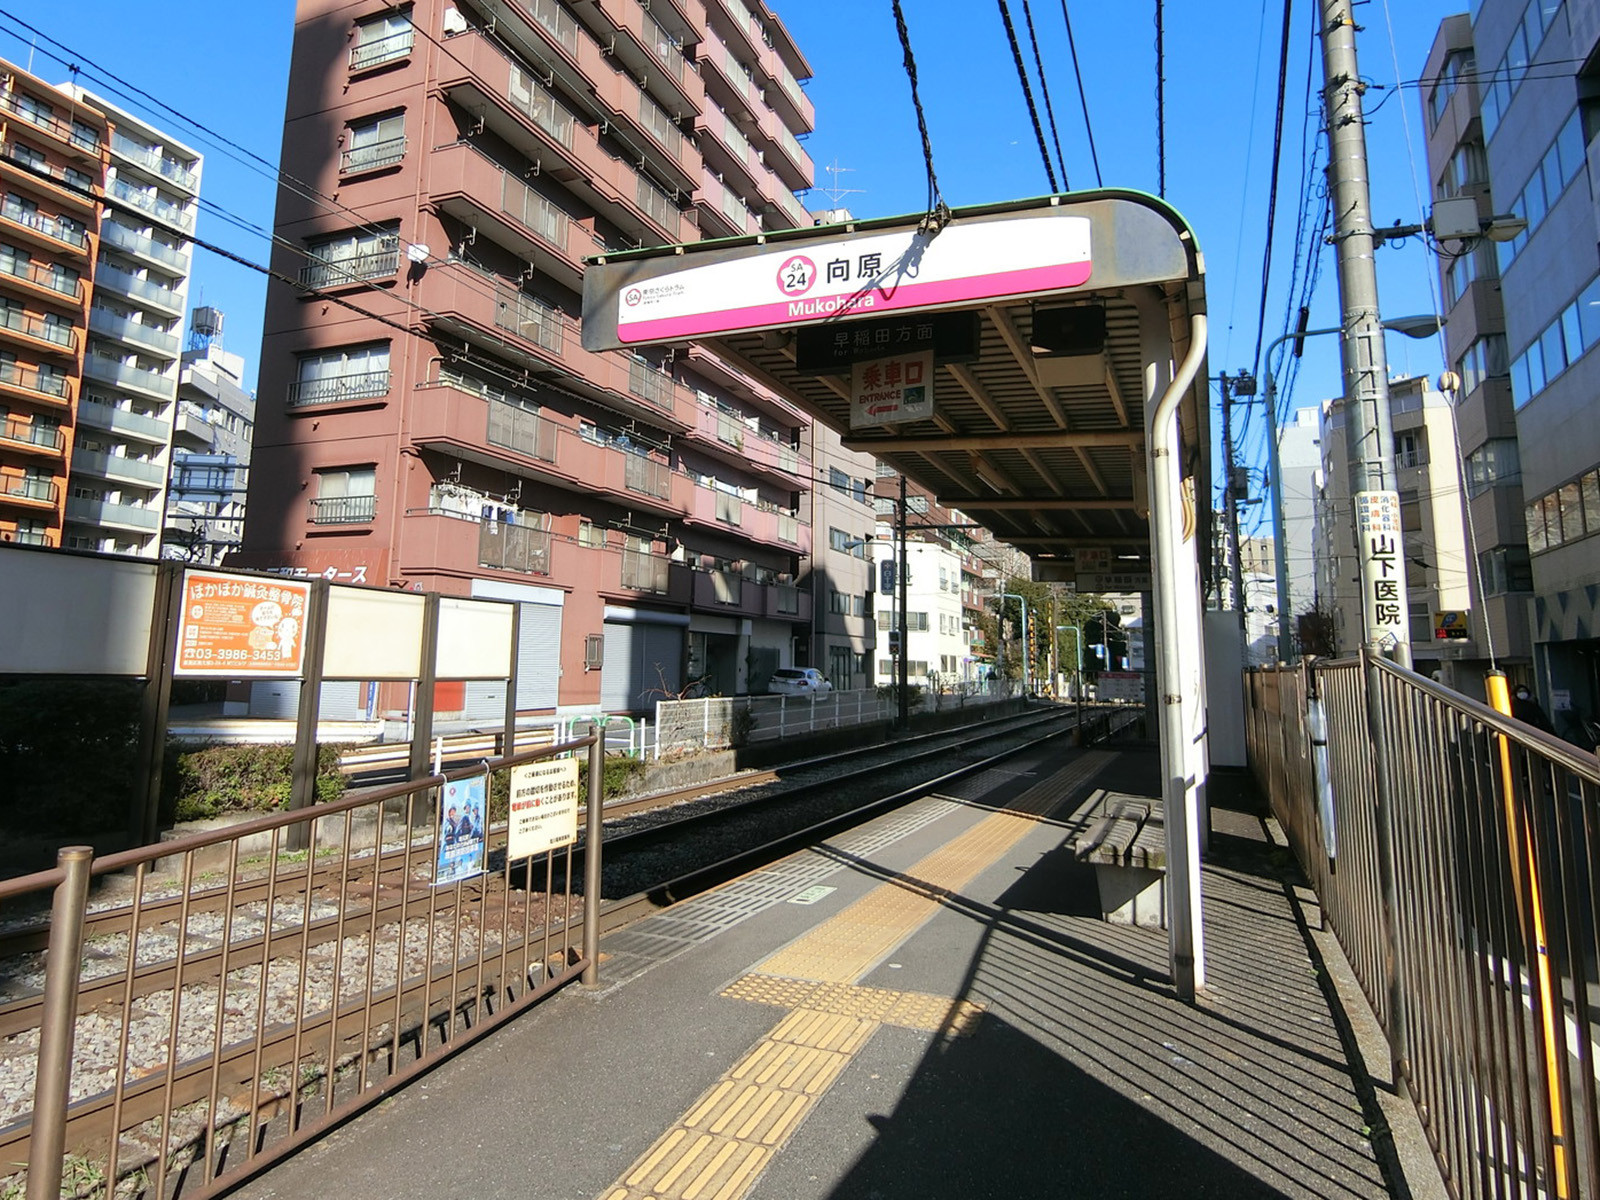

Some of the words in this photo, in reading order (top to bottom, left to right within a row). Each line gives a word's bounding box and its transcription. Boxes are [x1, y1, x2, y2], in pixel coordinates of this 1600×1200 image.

[790, 263, 804, 272] SA
[826, 252, 883, 284] 向原
[786, 272, 807, 288] 24
[628, 293, 639, 302] SA
[788, 295, 875, 317] Mukohara
[833, 323, 934, 348] 早稲田方面
[833, 348, 849, 357] for
[862, 360, 924, 392] 乗車口
[858, 389, 902, 405] ENTRANCE
[1370, 495, 1382, 532] 皮膚科
[1380, 495, 1392, 532] 消化器科
[1370, 533, 1401, 626] 山下医院
[196, 648, 282, 661] 03-3986-3453
